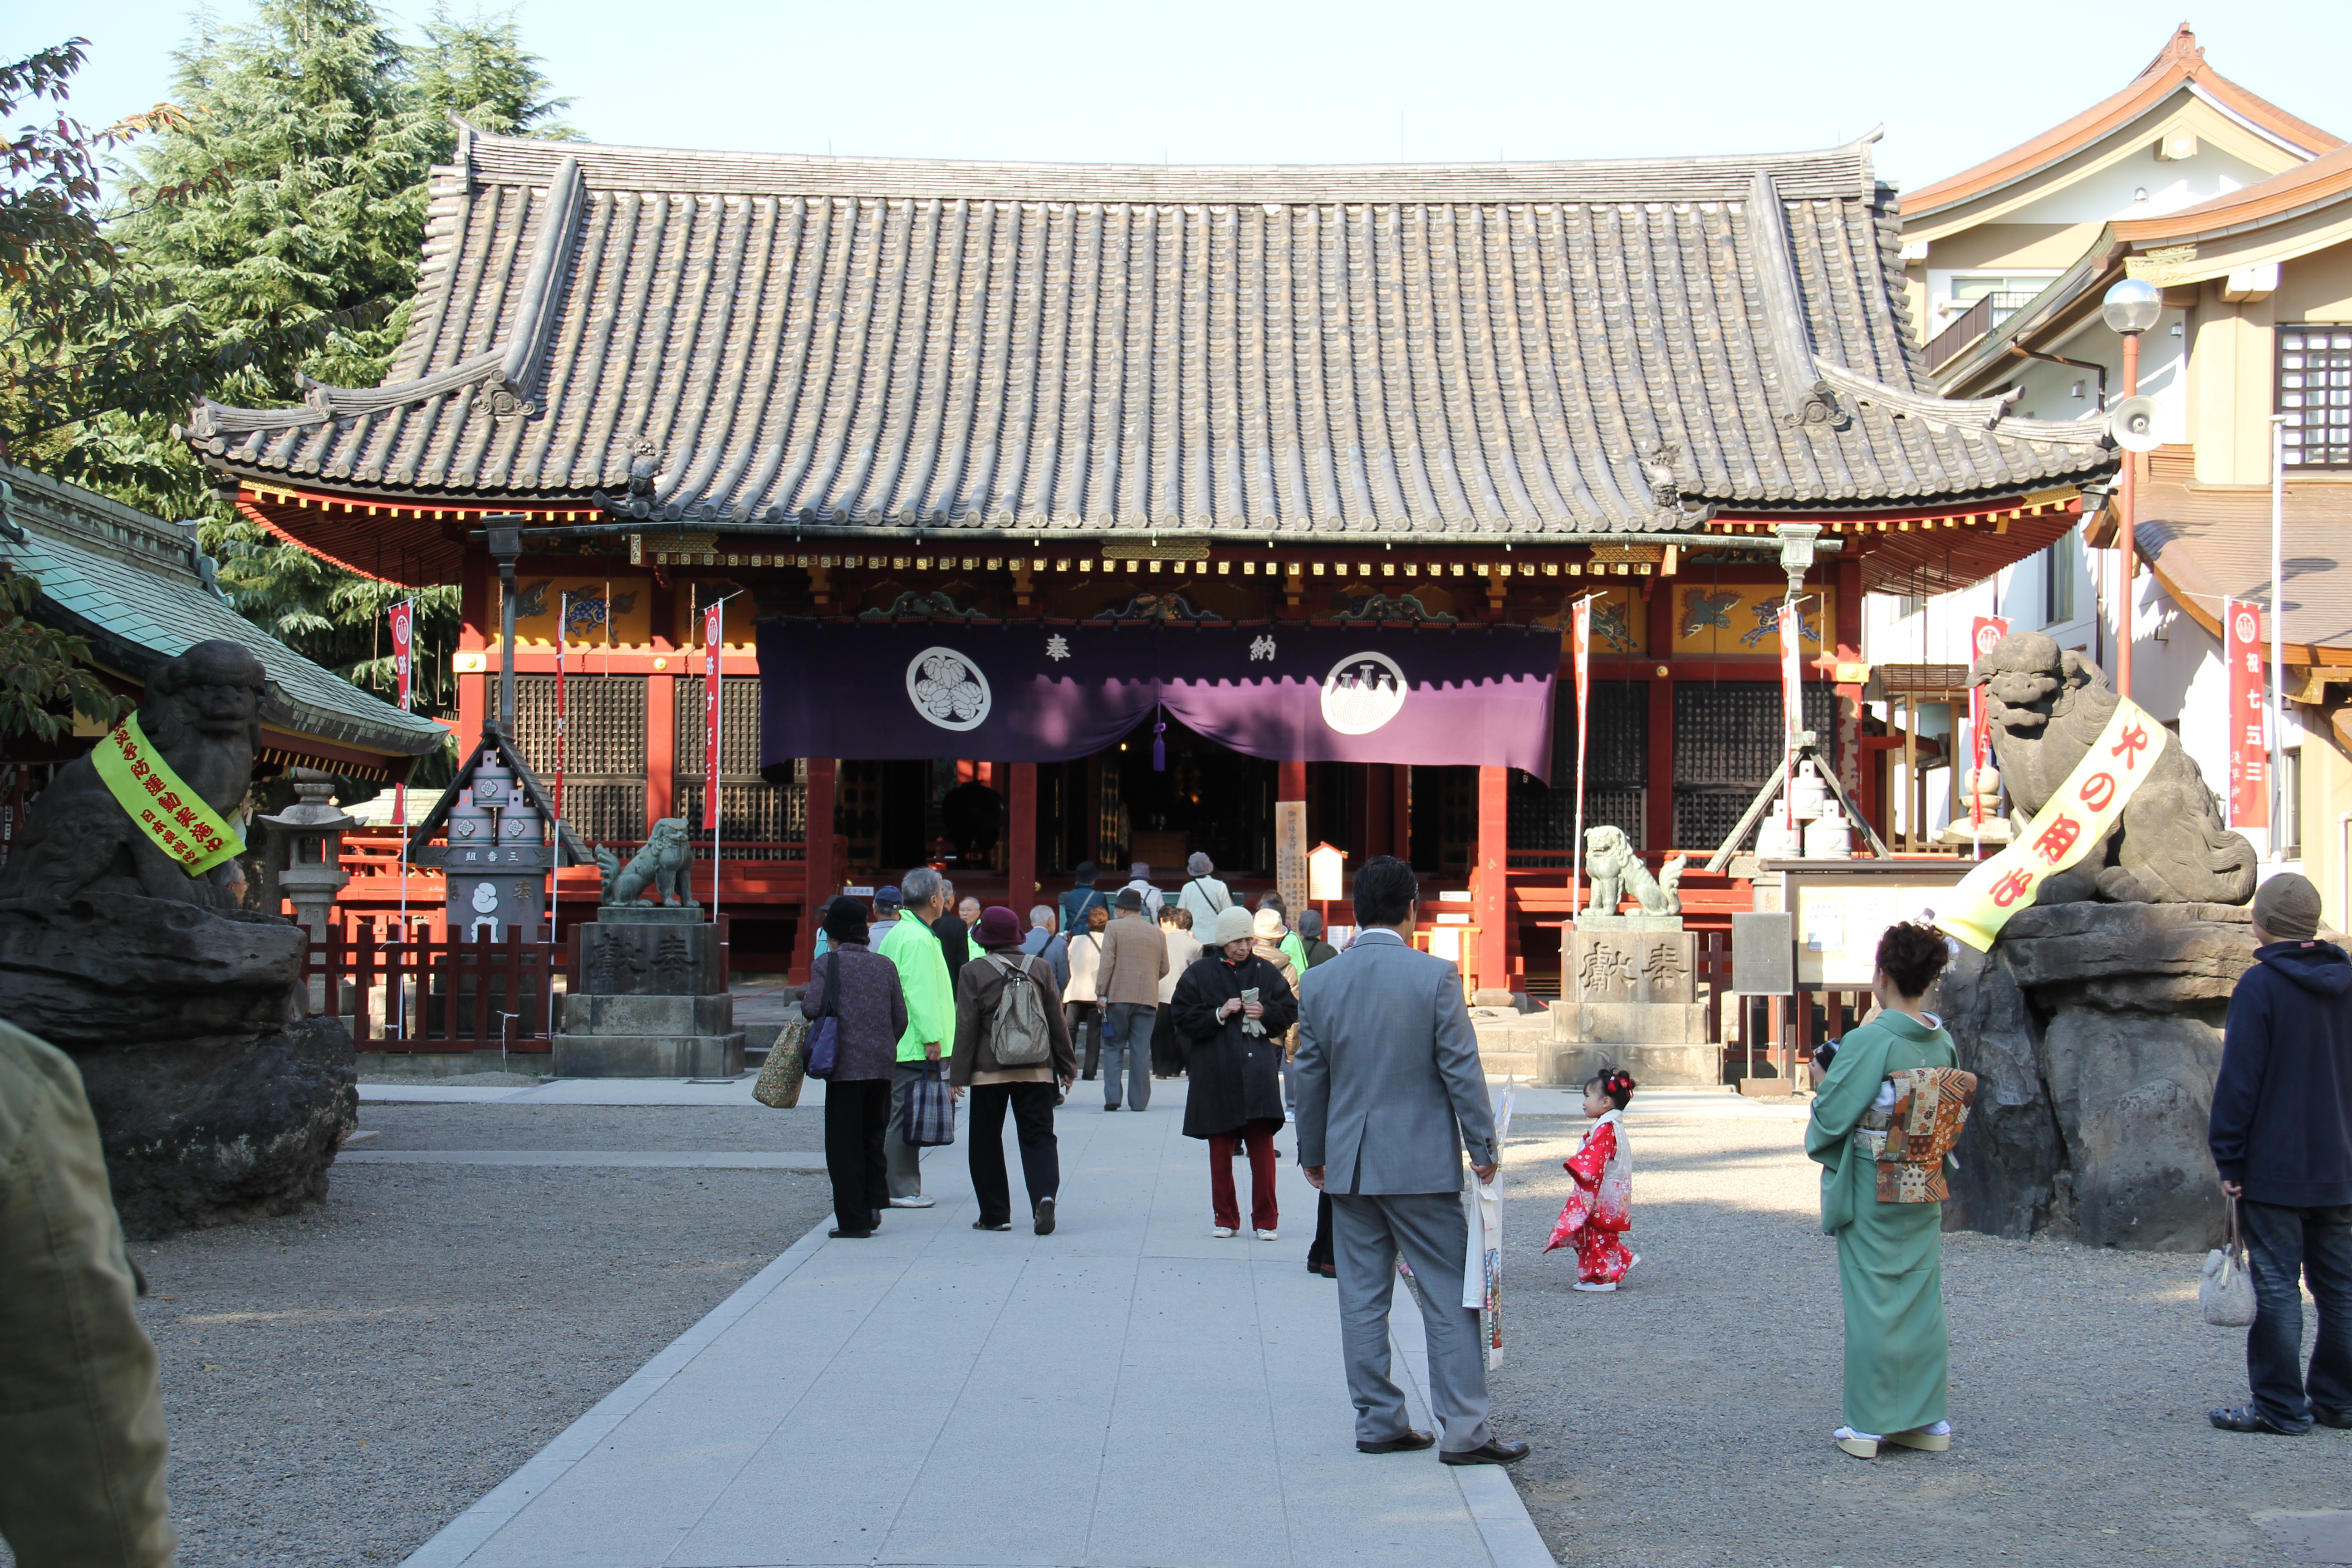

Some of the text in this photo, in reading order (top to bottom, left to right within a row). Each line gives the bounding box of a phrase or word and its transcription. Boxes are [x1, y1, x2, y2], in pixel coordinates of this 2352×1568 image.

[1046, 633, 1276, 662] 奉 納
[2245, 652, 2263, 781] 祝七五三
[1989, 722, 2148, 907] 火の用心
